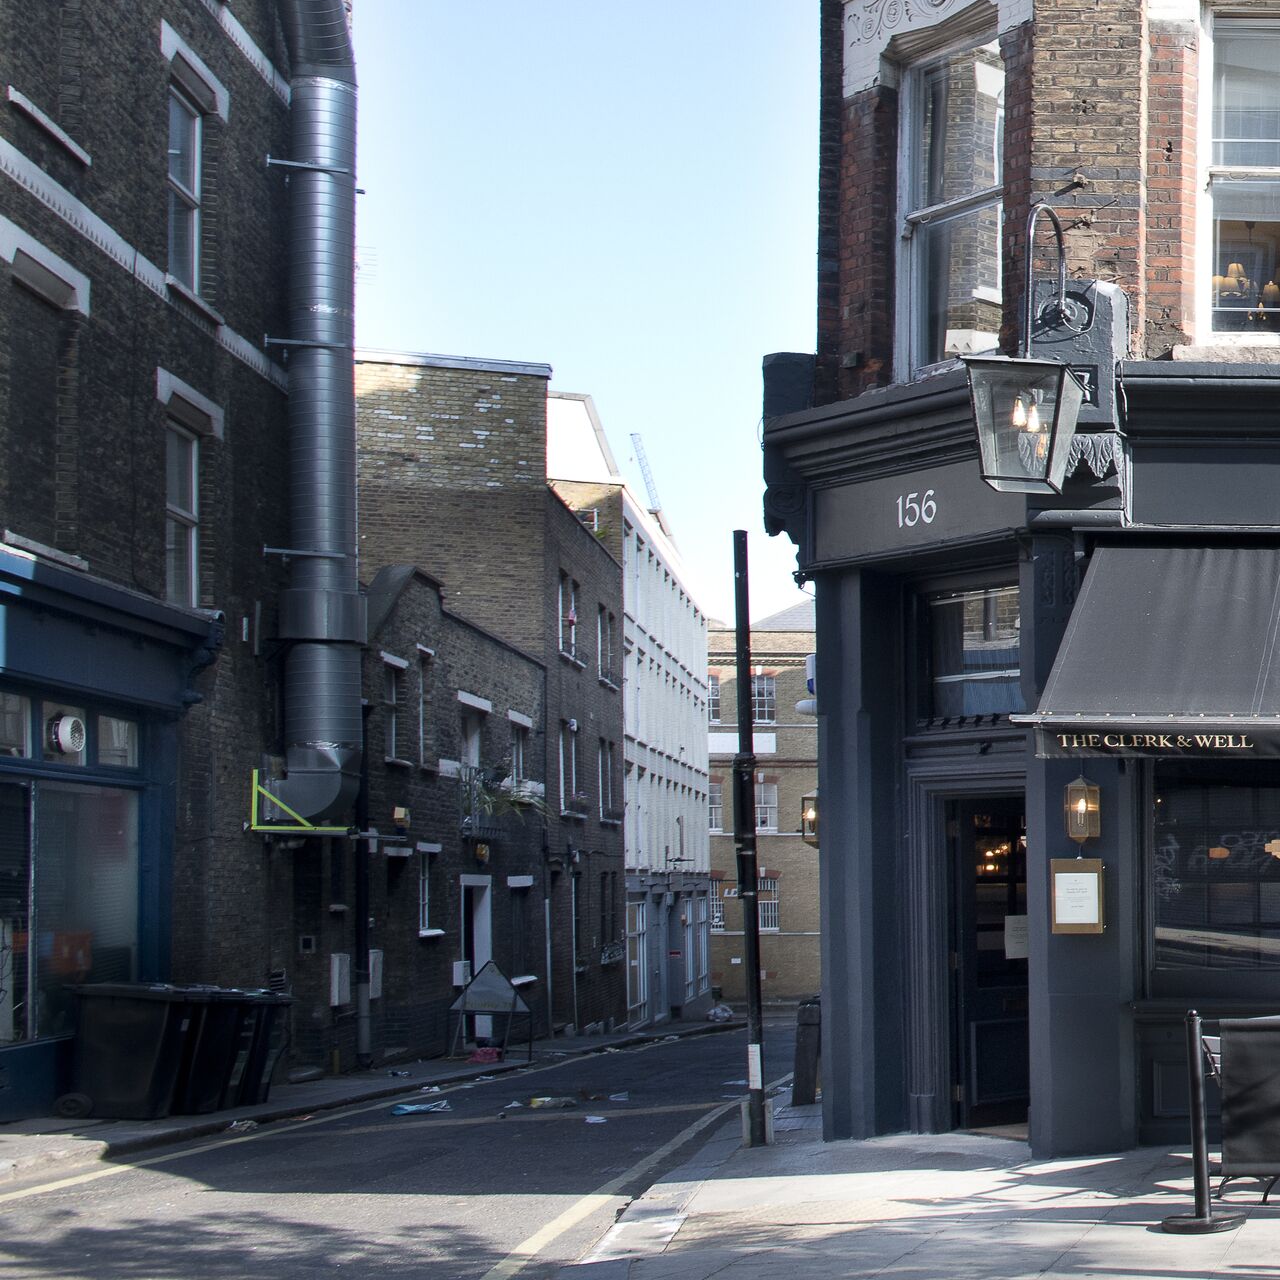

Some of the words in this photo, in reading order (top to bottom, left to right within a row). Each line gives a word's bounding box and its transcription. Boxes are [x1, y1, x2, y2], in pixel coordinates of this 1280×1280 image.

[896, 489, 937, 529] 156
[1056, 734, 1100, 748] THE
[1103, 734, 1174, 748] CLERK
[1176, 734, 1192, 748] &
[1194, 734, 1254, 748] WELL
